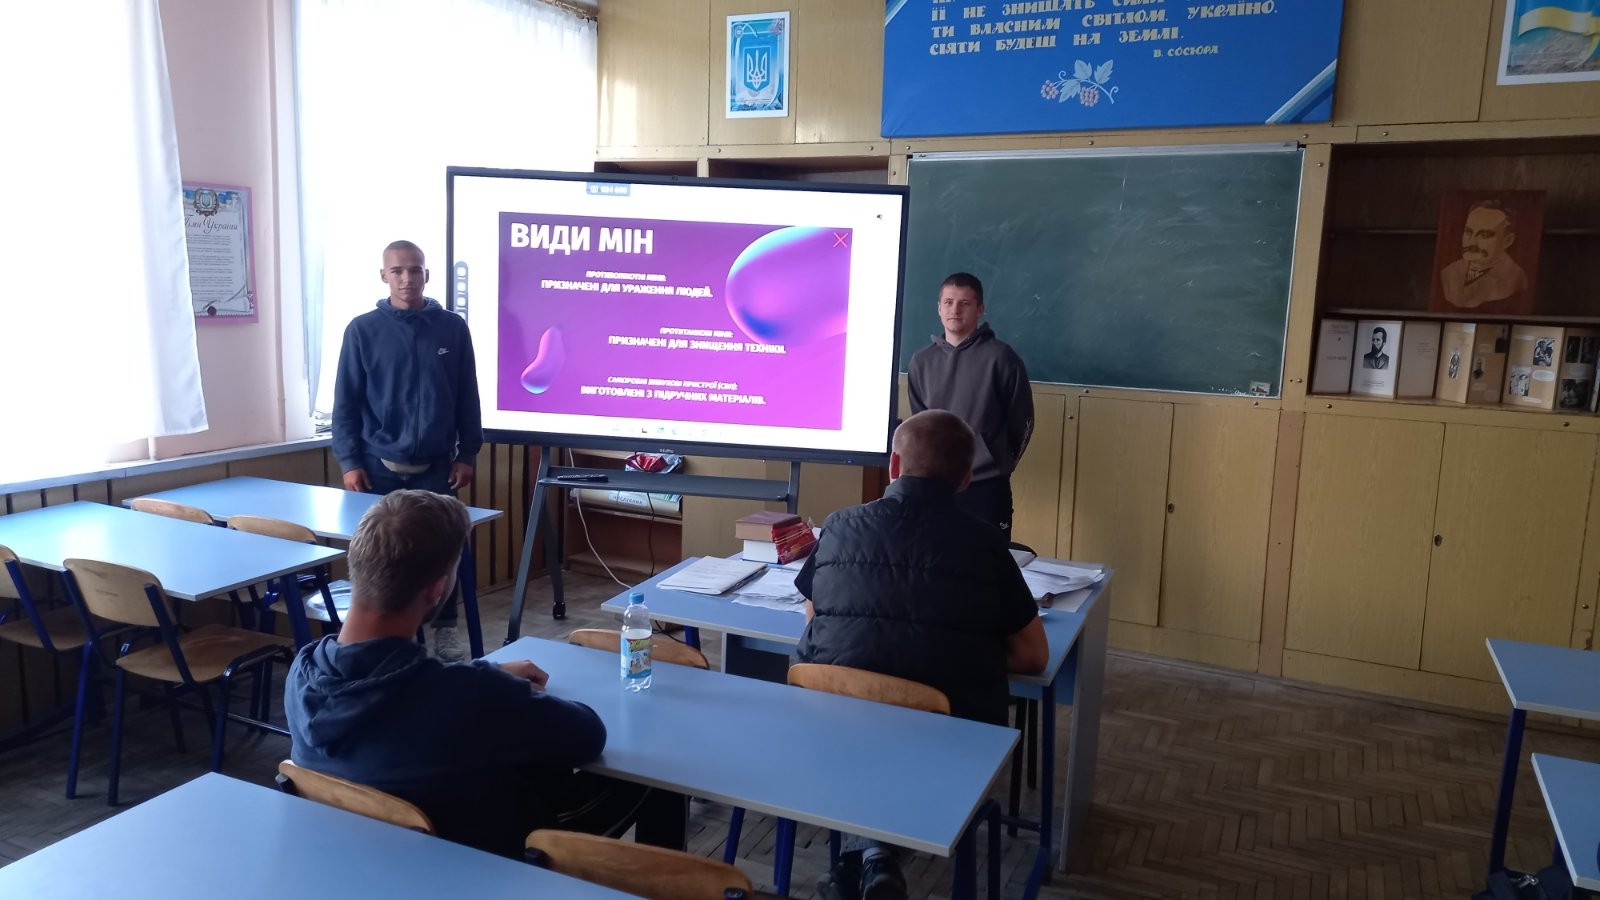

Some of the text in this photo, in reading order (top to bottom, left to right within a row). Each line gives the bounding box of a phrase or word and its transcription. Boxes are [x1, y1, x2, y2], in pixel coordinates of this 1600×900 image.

[963, 5, 986, 19] НЕ
[931, 25, 955, 38] ТИ
[970, 17, 1061, 36] ВЛАСНИМ
[1081, 9, 1168, 28] СВІТЛОМ.
[929, 26, 1184, 56] СІЯТИ БУДЕШ НА ЗЕМЛІ.
[1167, 45, 1219, 57] СОСЮРА
[510, 222, 654, 256] ВИДИ МІН
[541, 279, 713, 298] ПРИЗНАЧЕНІ ДЛЯ УРАЖЕННЯ ЛЮДЕЙ.
[608, 335, 787, 354] ПРИЗНАЧЕНІ ДЛЯ ЗНИЩЕННЯ ТЕХНІКИ.
[580, 385, 645, 398] ВИГОТОВЛЕНІ
[654, 389, 707, 402] ПІДРУЧНИХ
[708, 392, 767, 405] МАТЕРІАЛІВ.
